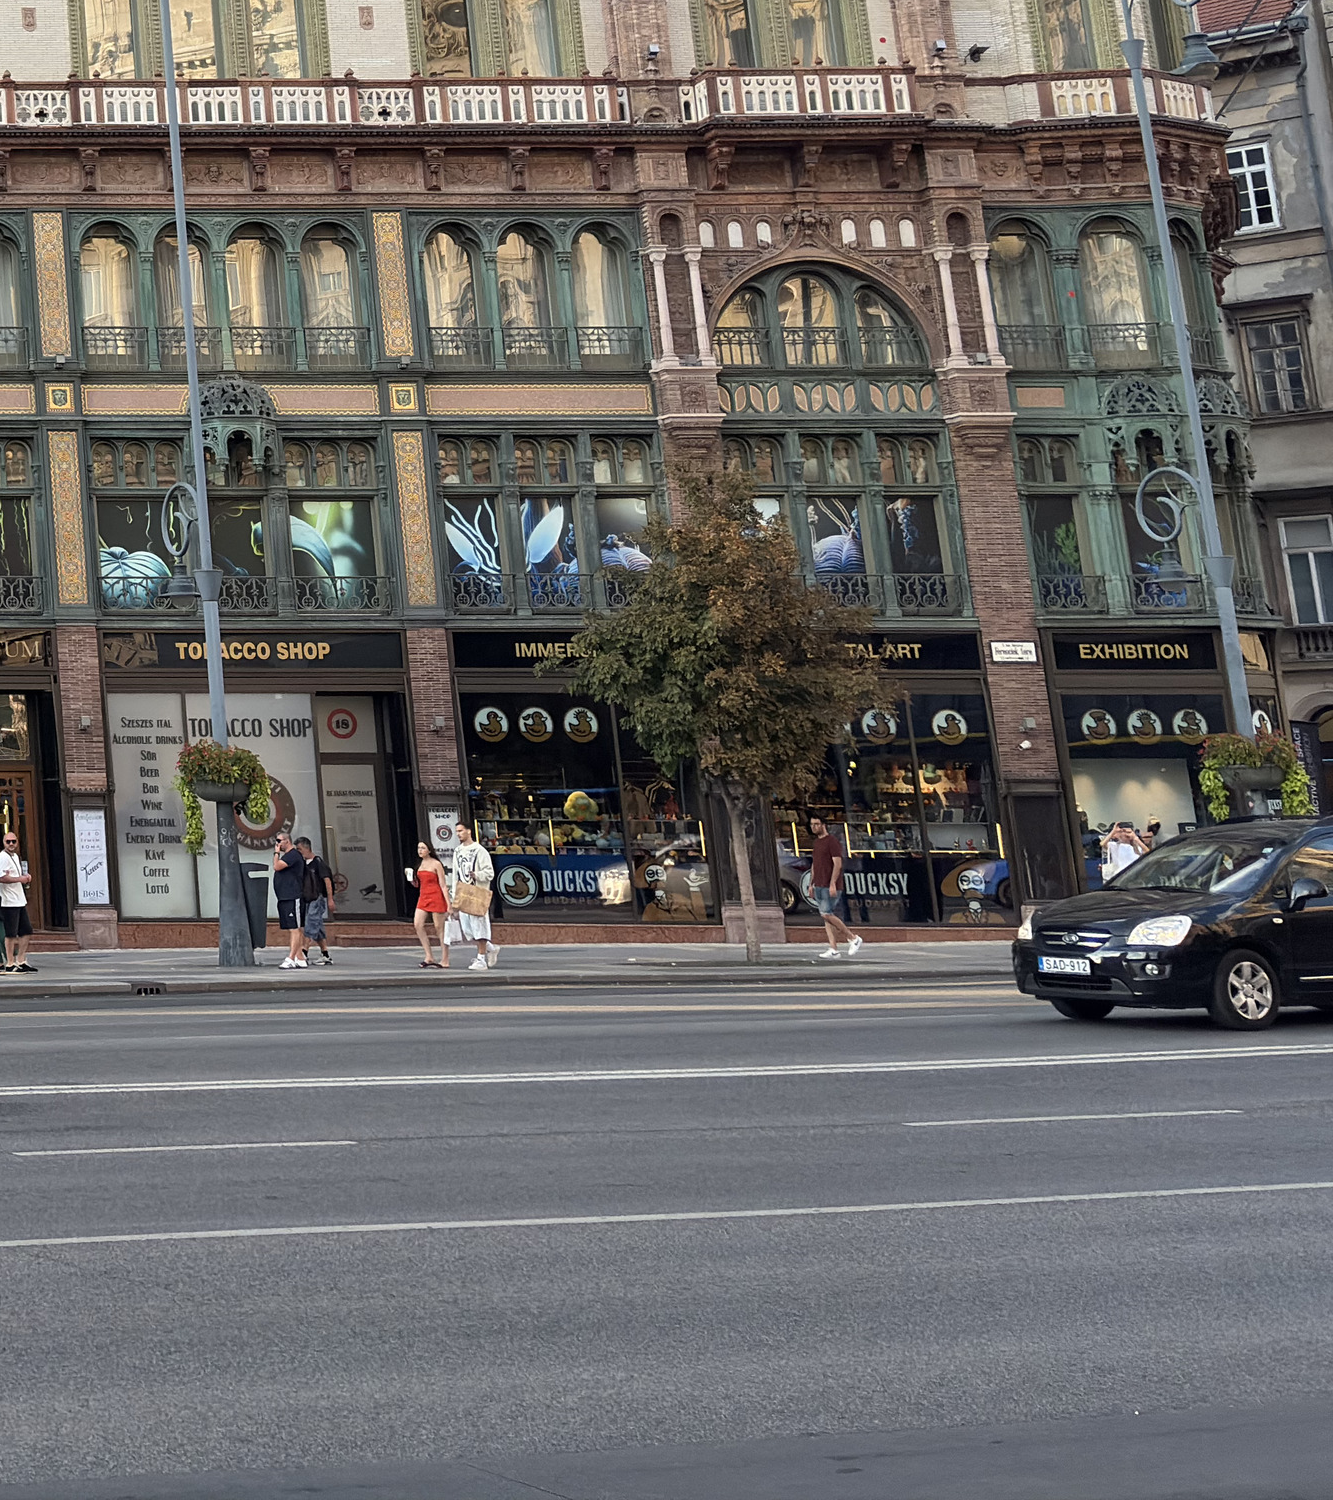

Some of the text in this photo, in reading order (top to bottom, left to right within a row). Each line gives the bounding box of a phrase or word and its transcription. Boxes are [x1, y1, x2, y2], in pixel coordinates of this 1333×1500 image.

[175, 642, 330, 660] TOACCO SHOP
[885, 643, 922, 659] ART
[1078, 643, 1189, 659] EXHIBITION
[269, 718, 312, 738] SHOP
[336, 719, 350, 729] 18
[155, 735, 183, 744] DRINKS
[139, 766, 160, 777] BEER
[141, 799, 163, 810] WINE
[125, 832, 155, 843] ENERGY
[143, 865, 170, 877] COFFEE
[843, 872, 908, 895] DUCKSY
[83, 889, 105, 898] BOIS
[1045, 958, 1088, 972] SAD-912
